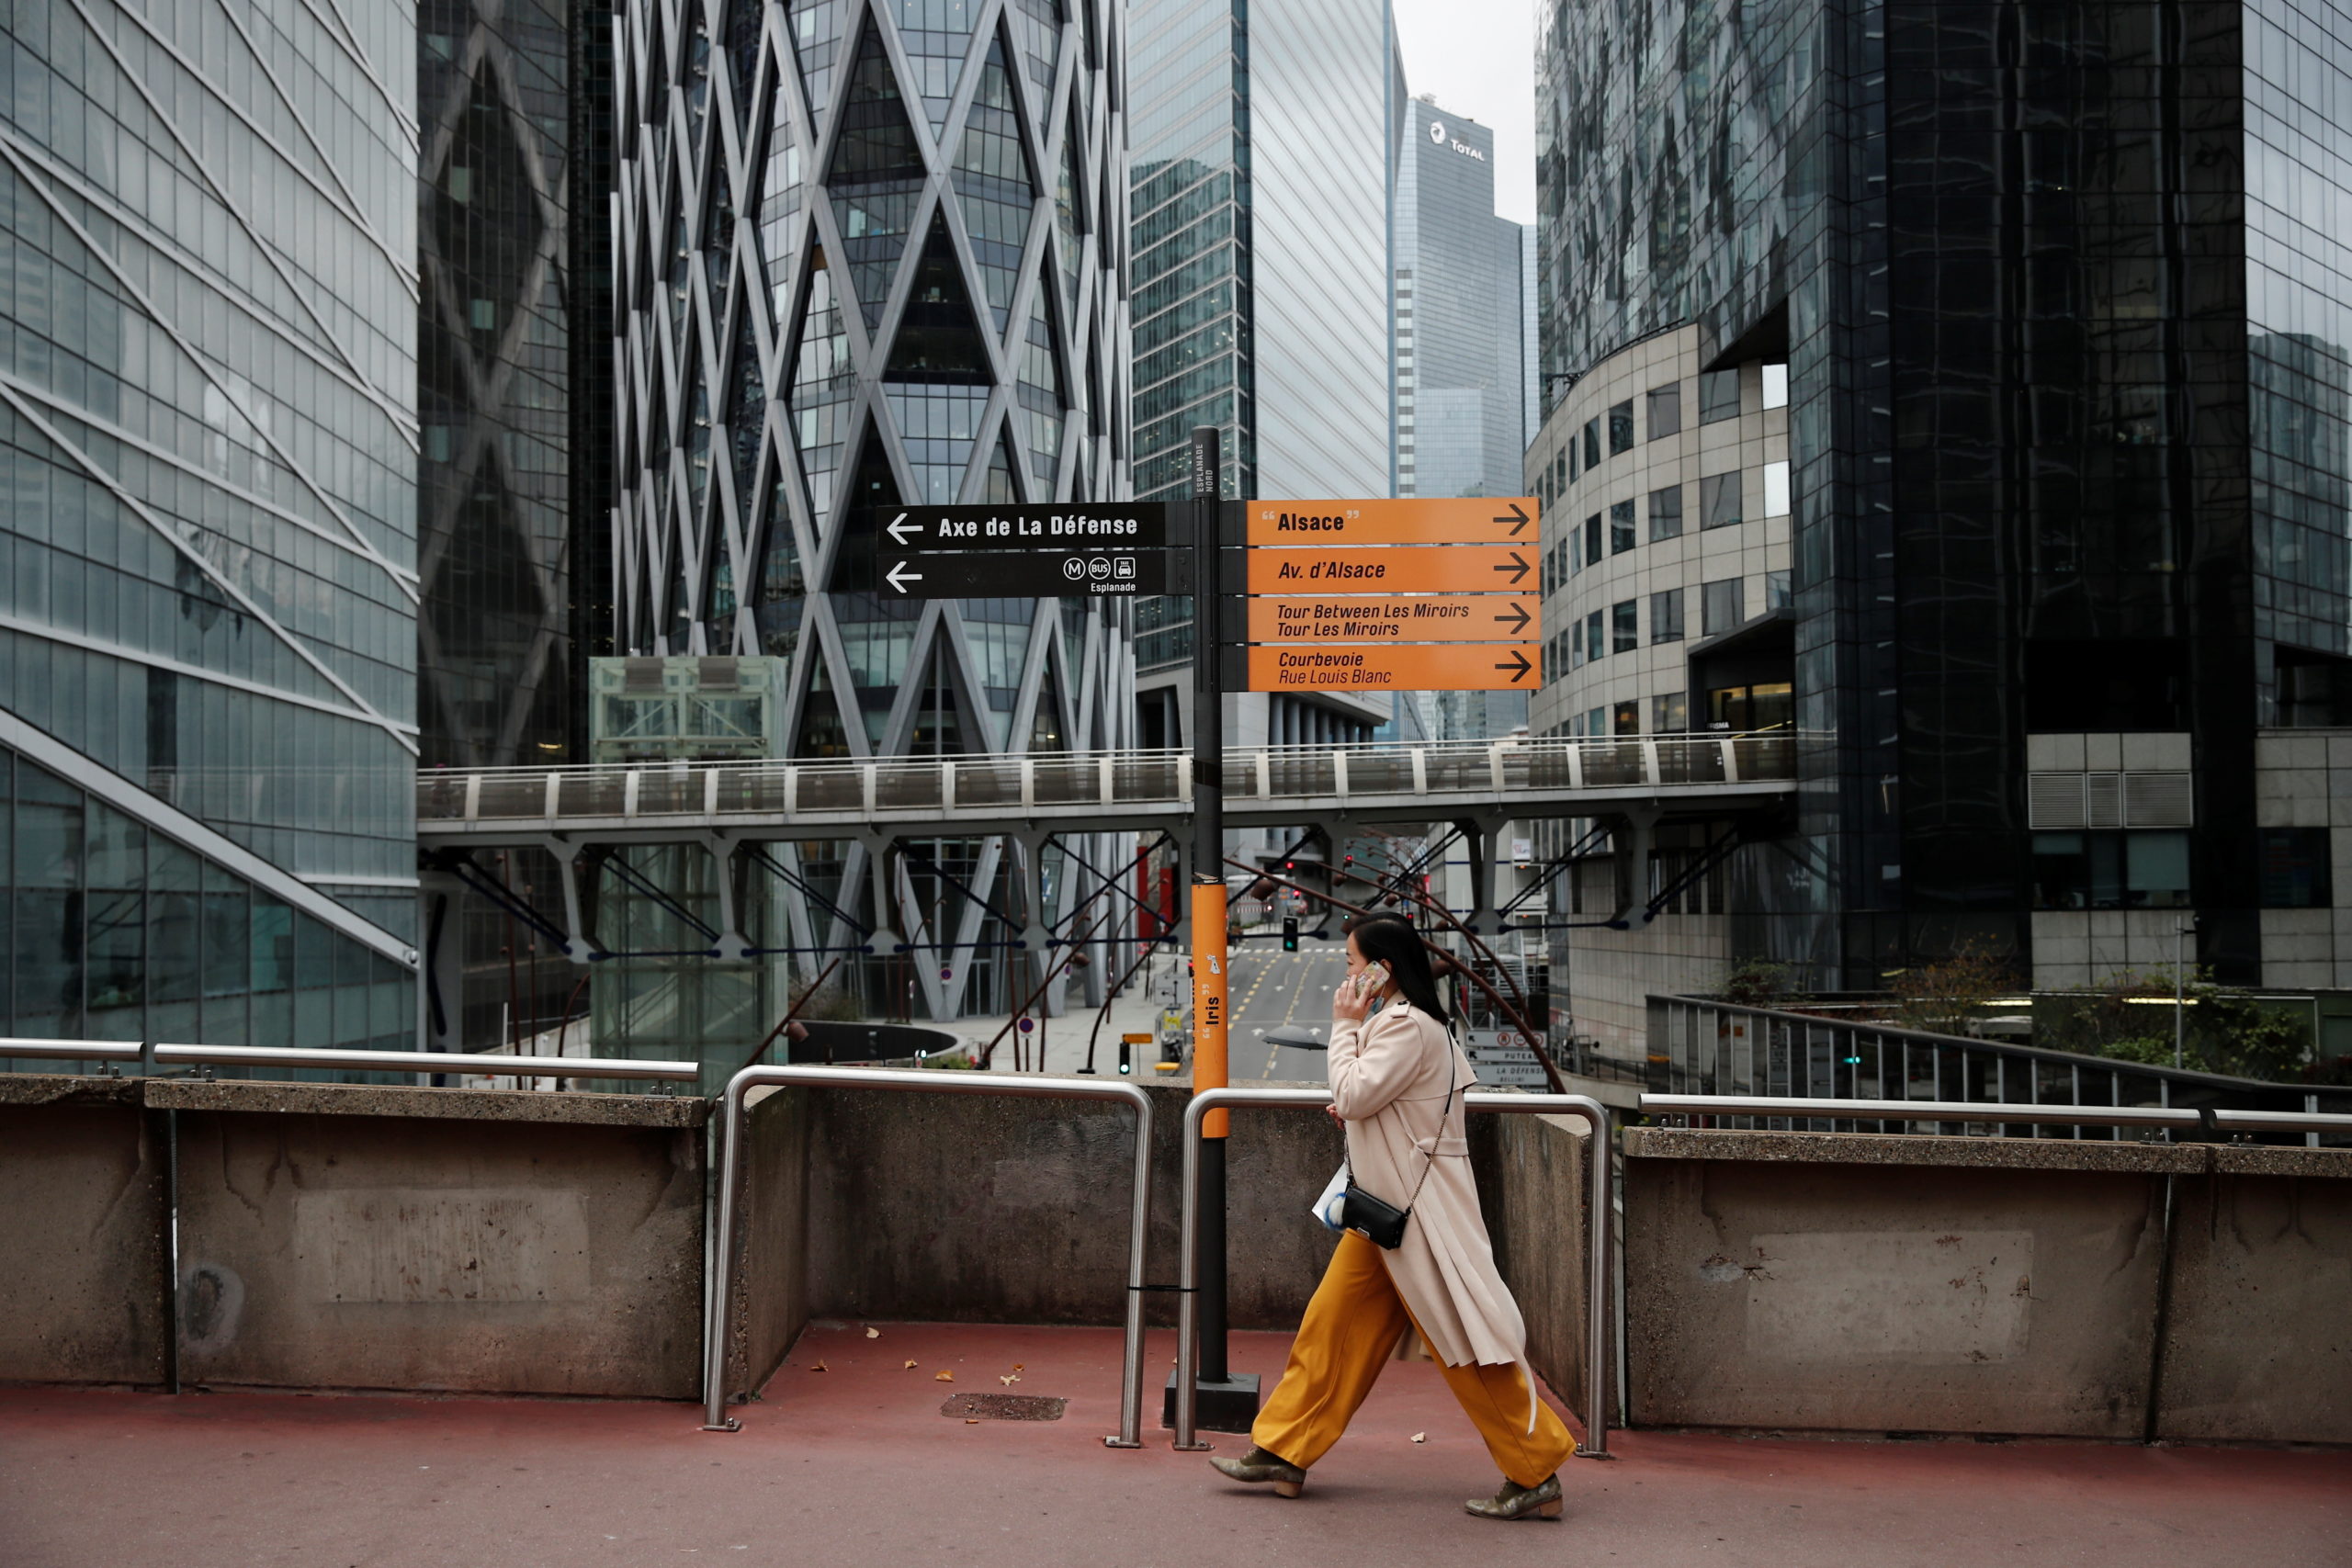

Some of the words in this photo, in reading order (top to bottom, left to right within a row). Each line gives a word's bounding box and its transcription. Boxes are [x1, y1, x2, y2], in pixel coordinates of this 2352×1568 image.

[1450, 138, 1485, 162] TOTAL
[1196, 444, 1204, 492] ESPLANADE
[1205, 469, 1214, 492] NORD
[939, 517, 978, 537] Axe
[985, 516, 1011, 536] de
[1019, 516, 1042, 536] La
[1050, 514, 1137, 536] Défense
[1091, 563, 1108, 573] BUS
[1278, 562, 1304, 579] Av.
[1309, 561, 1385, 579] d’Alsace
[1091, 581, 1136, 593] Esplanade
[1277, 604, 1310, 619] Tour
[1314, 604, 1380, 618] Between
[1384, 604, 1409, 618] Les
[1413, 603, 1469, 617] Miroirs
[1277, 622, 1310, 637] Tour
[1314, 622, 1340, 637] Les
[1343, 621, 1399, 636] Miroirs
[1278, 652, 1363, 667] Courbevoie
[1279, 670, 1306, 684] Rue
[1310, 670, 1348, 683] Louis
[1351, 669, 1392, 683] Blanc
